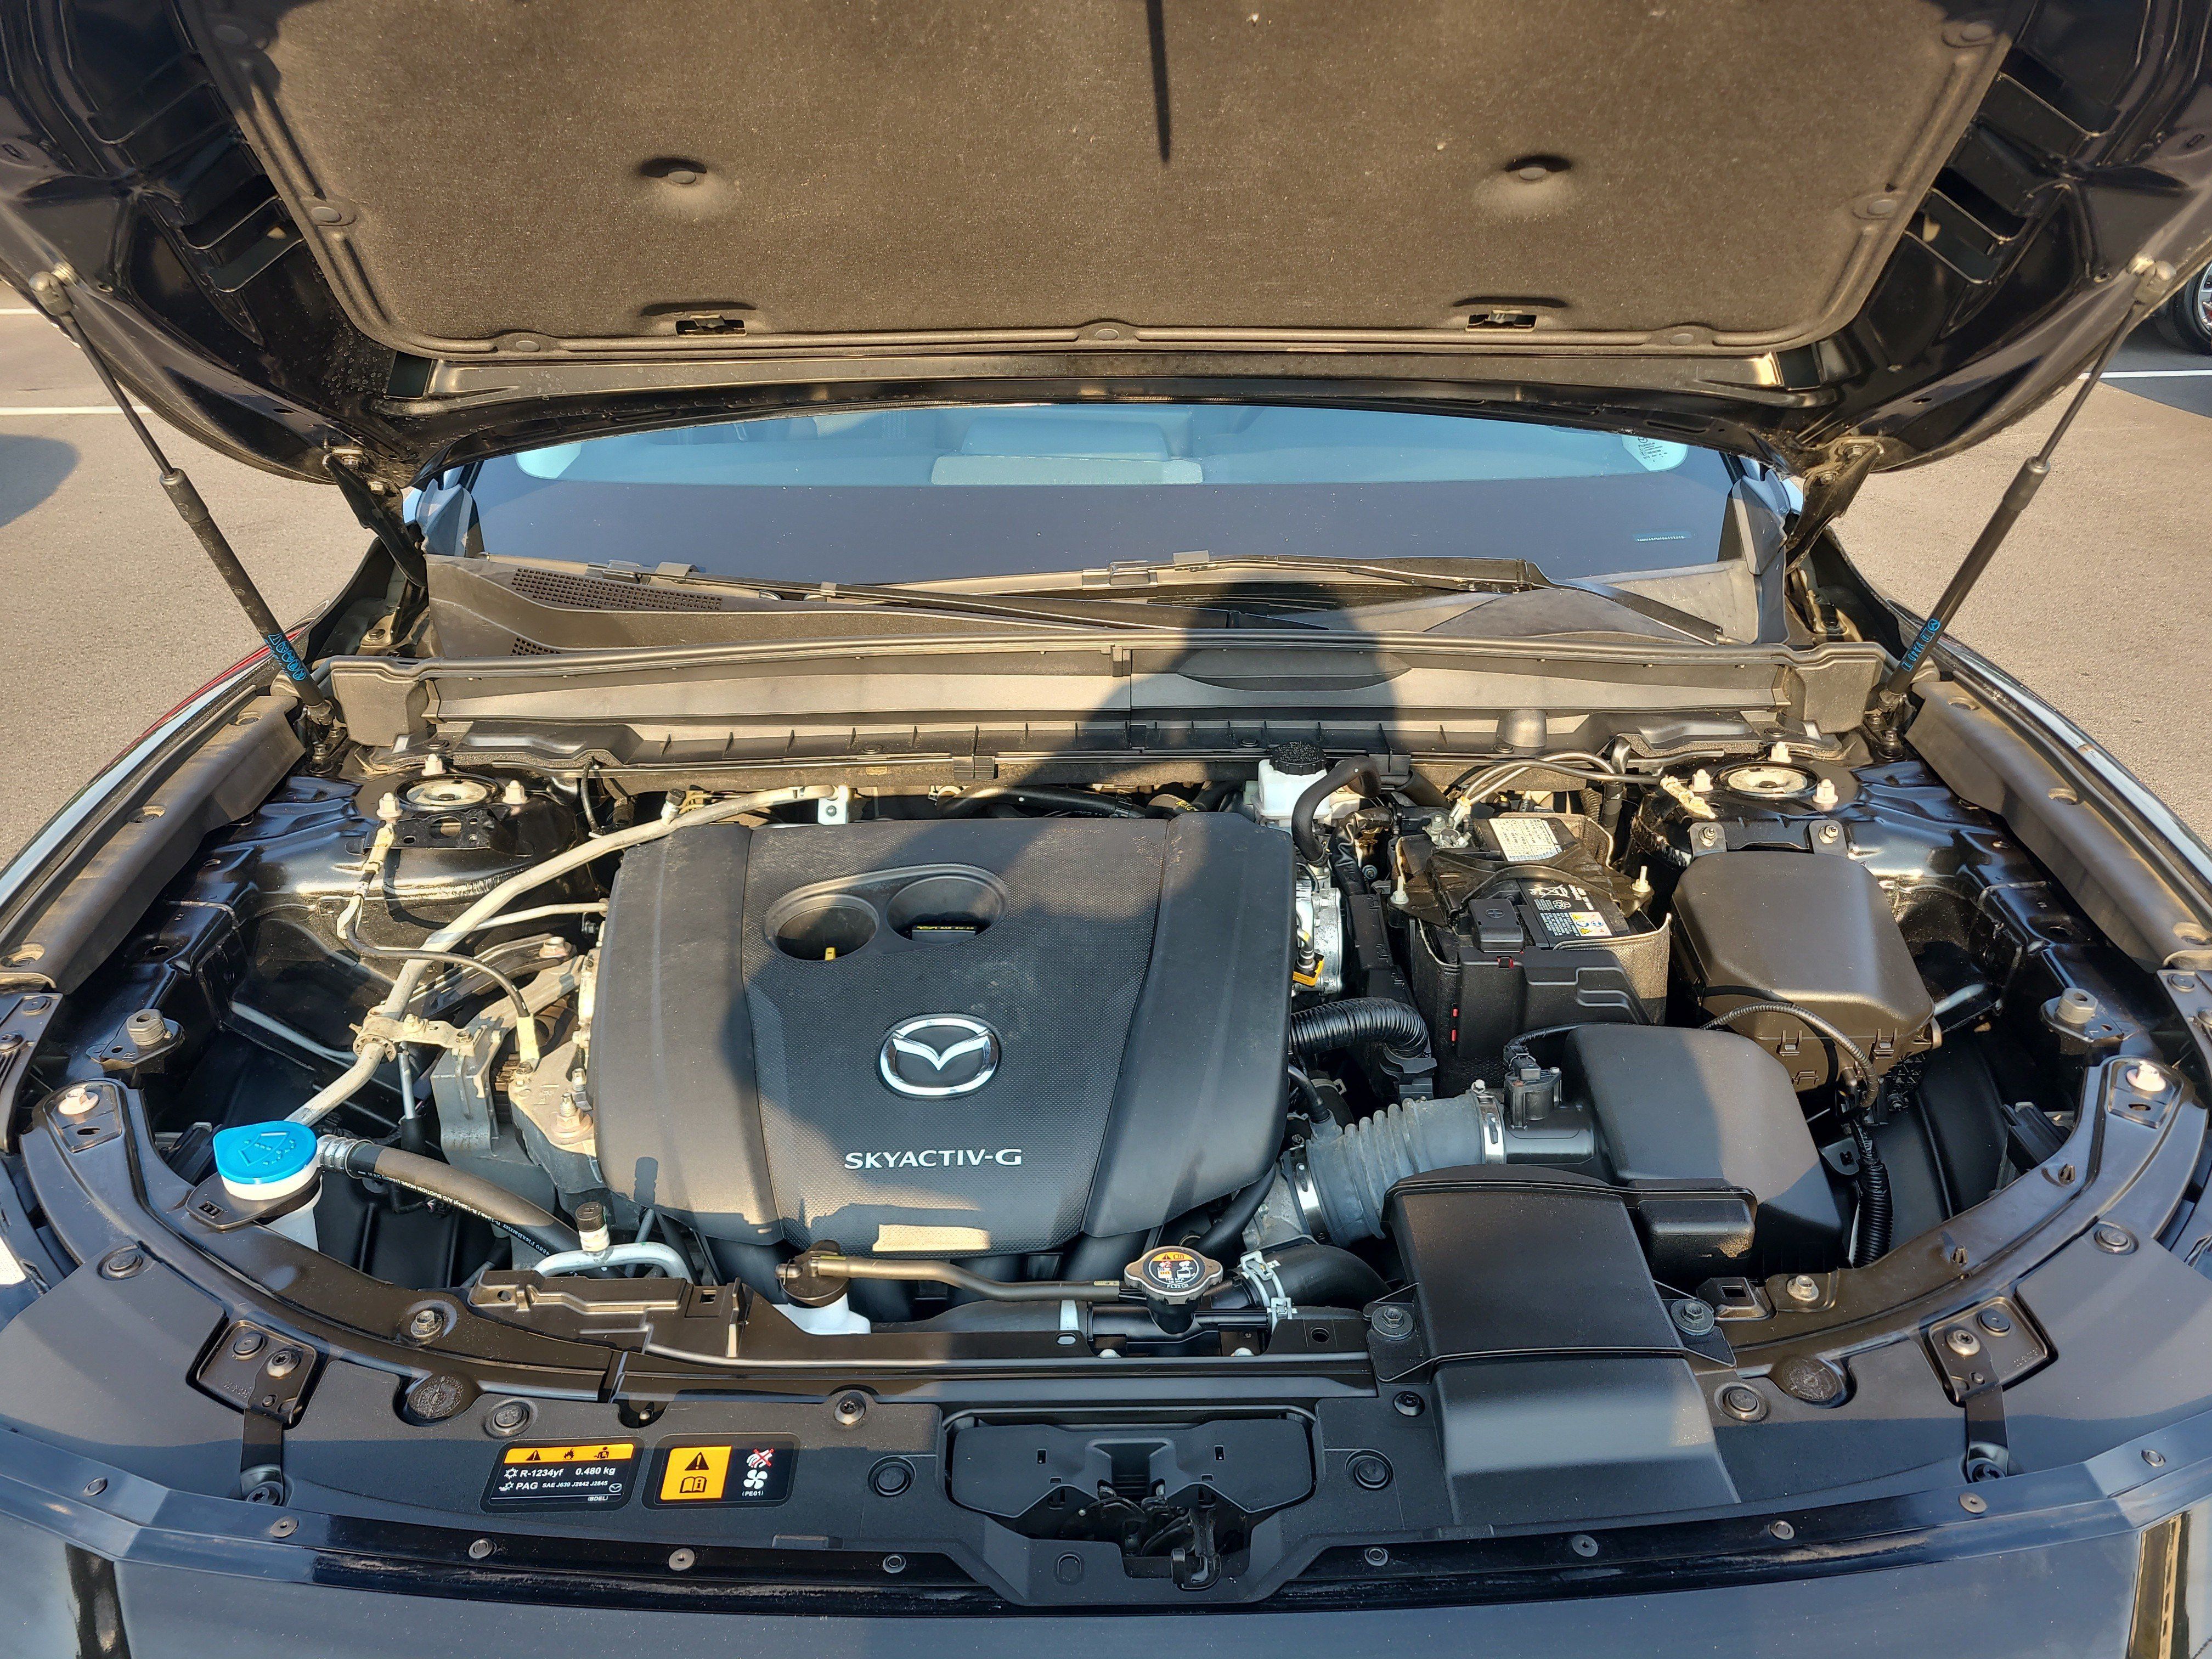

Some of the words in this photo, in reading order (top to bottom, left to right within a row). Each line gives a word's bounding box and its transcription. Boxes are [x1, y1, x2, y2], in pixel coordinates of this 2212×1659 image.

[844, 1148, 1022, 1170] SKYACTIV-G
[399, 1180, 416, 1189] HOSE
[416, 1186, 442, 1199] SUCTION
[520, 1468, 564, 1478] R-1234yf
[575, 1467, 601, 1476] 0.480
[603, 1466, 616, 1475] kg
[516, 1482, 539, 1490] PAG
